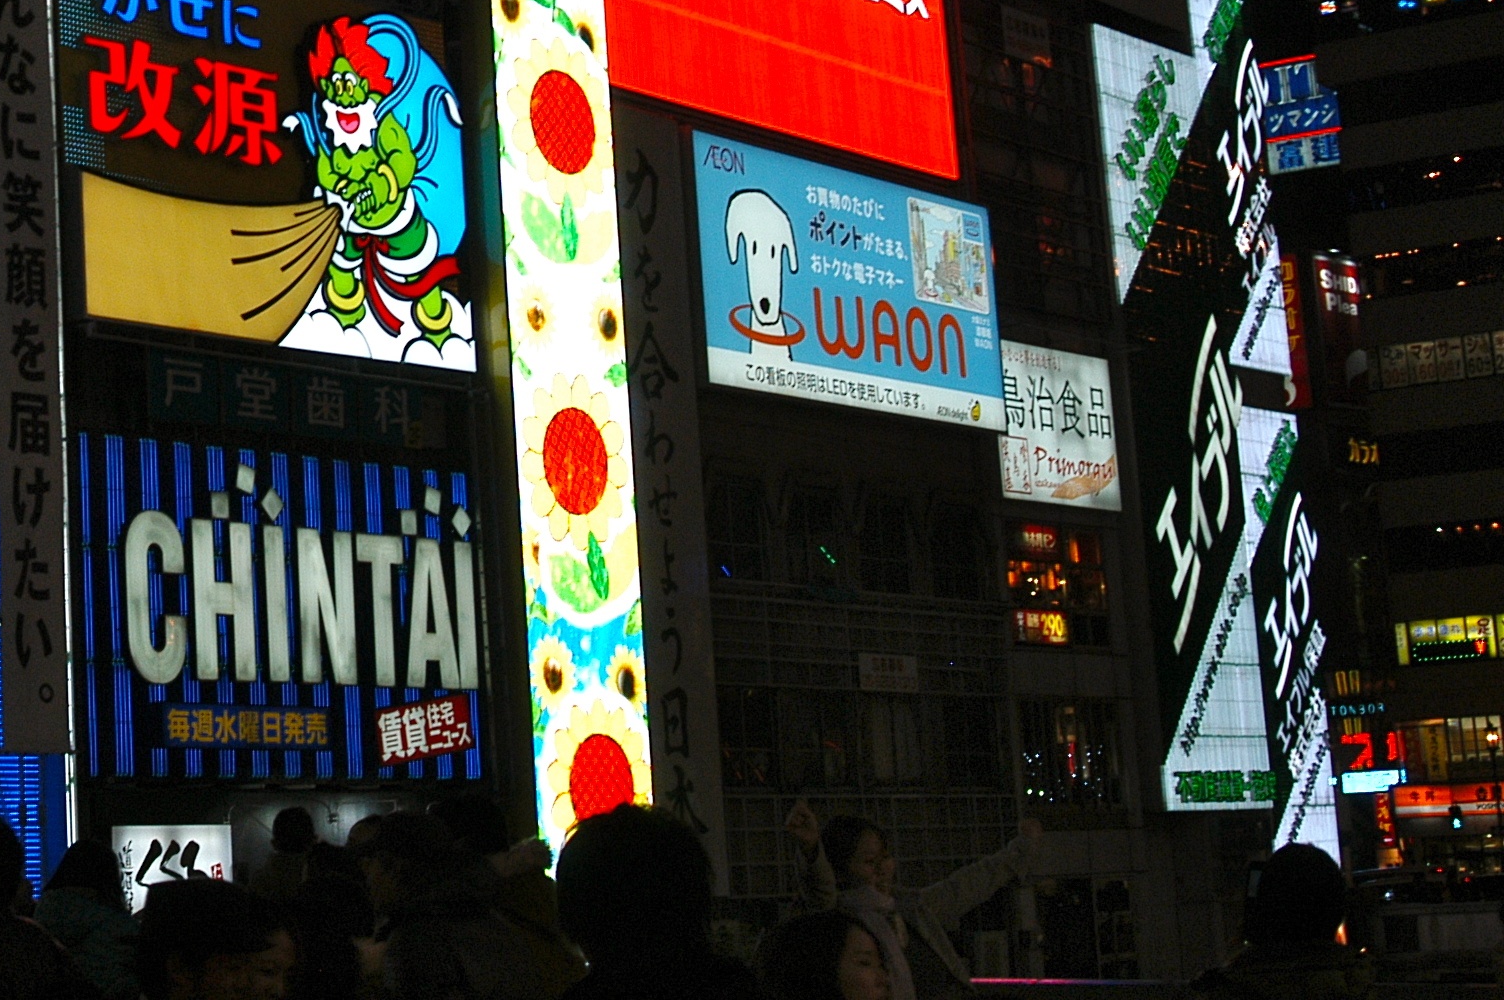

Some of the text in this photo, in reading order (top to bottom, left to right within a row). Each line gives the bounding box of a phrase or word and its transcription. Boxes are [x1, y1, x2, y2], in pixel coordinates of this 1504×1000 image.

[83, 36, 284, 167] 改源
[805, 184, 886, 221] お買物のたびに
[810, 254, 905, 289] おトクな電子マネー
[814, 287, 967, 379] WAON
[123, 464, 473, 691] CHINTAI
[166, 709, 330, 745] 毎週水曜日発売
[378, 709, 429, 761] 賃貸
[429, 722, 472, 751] ニュース
